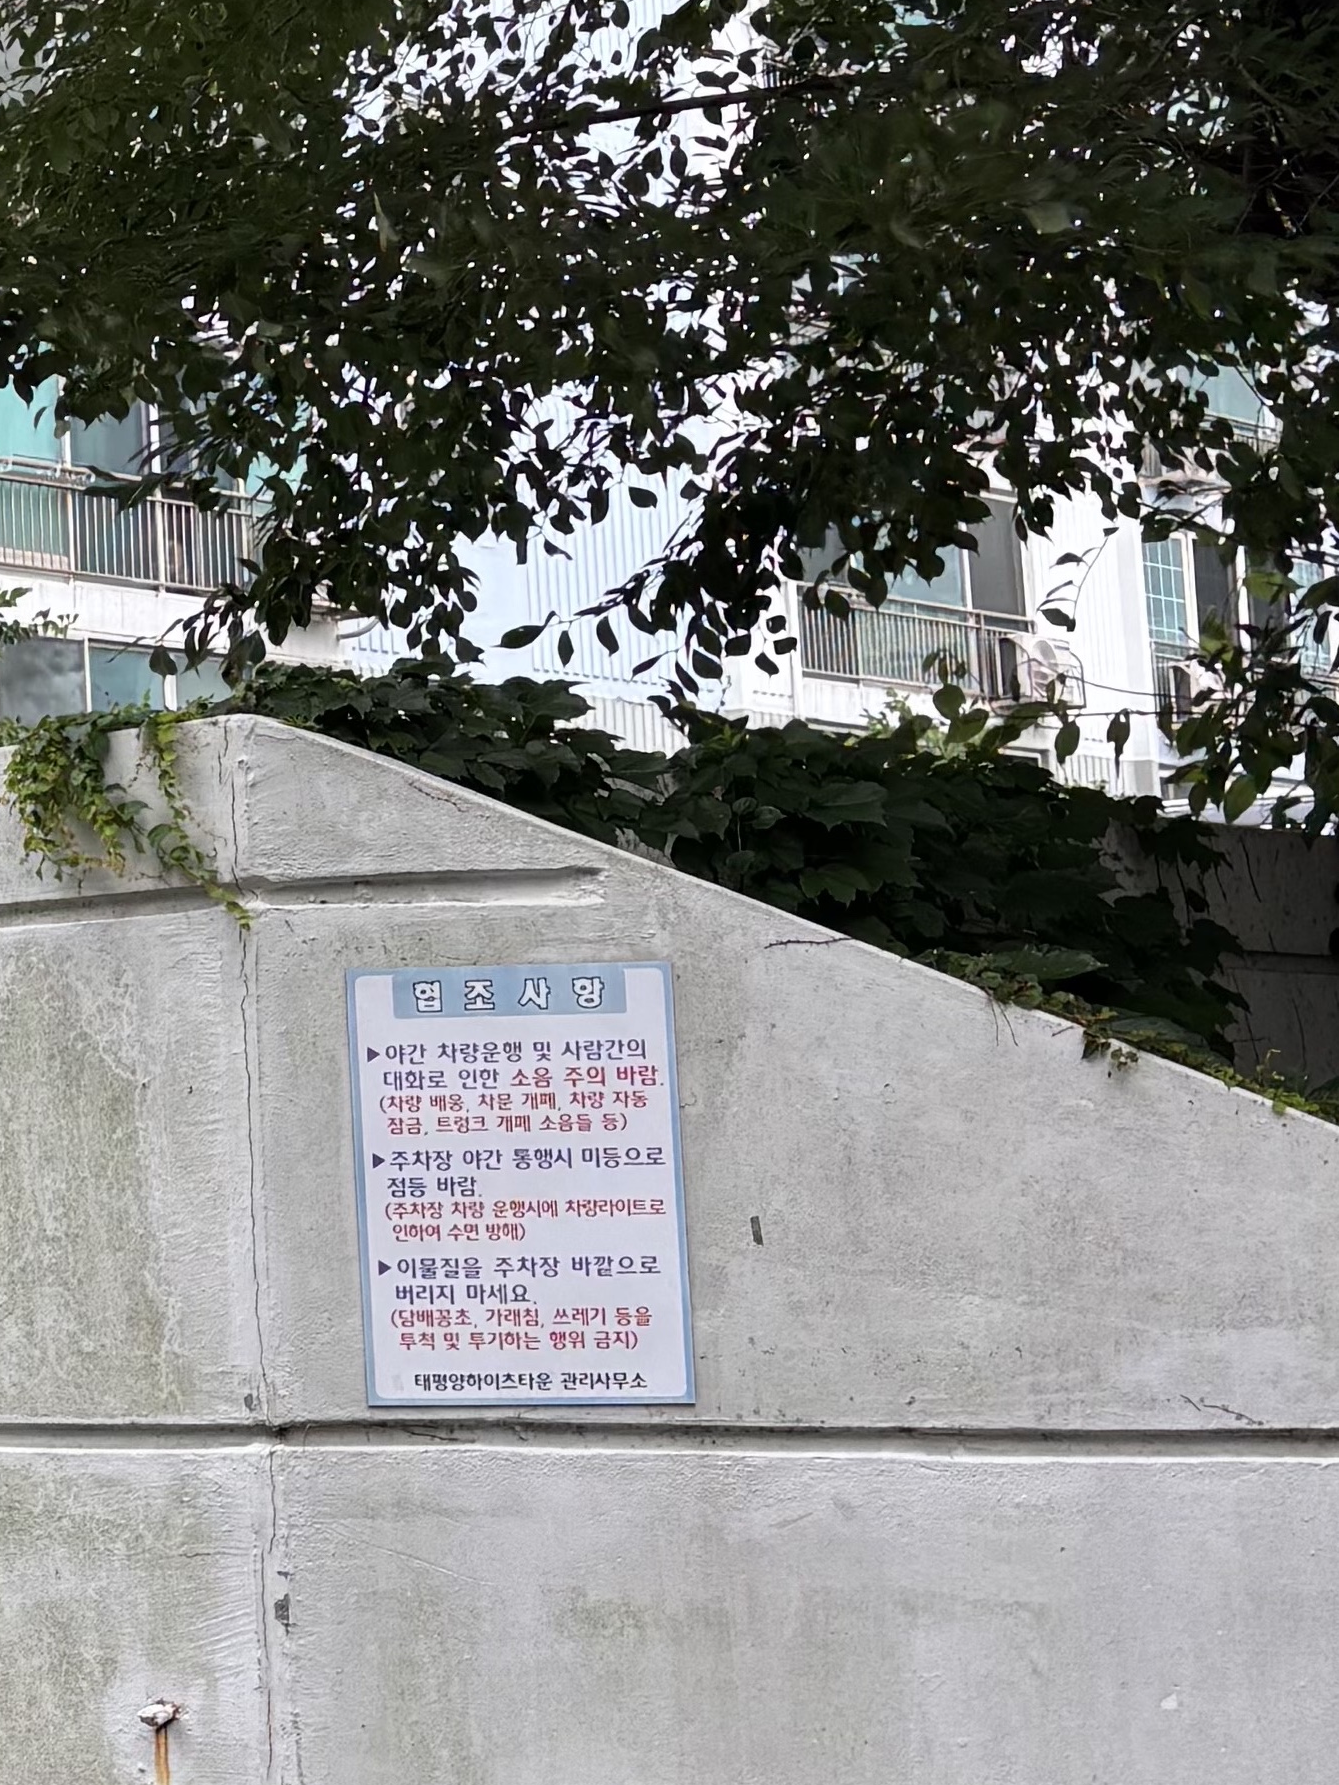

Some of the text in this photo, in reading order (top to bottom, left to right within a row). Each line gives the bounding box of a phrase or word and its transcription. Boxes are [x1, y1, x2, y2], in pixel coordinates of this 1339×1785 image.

[384, 1038, 647, 1066] 야간 차량운행 및 사람간의
[382, 1069, 449, 1092] 대화로
[457, 1067, 501, 1091] 인한
[563, 1065, 607, 1087] 주의
[616, 1064, 664, 1087] 바람.
[378, 1095, 423, 1115] (차량
[477, 1092, 514, 1112] 차문
[569, 1091, 605, 1110] 차량
[612, 1090, 649, 1109] 자동
[386, 1116, 429, 1136] 잠금,
[435, 1114, 489, 1134] 트렁크
[600, 1112, 628, 1131] 등)
[389, 1146, 667, 1172] 주차장 야간 통행시 미등으로
[386, 1176, 483, 1199] 점등 바람.
[384, 1198, 667, 1222] (주차장 차량 운행시에 차량라이트로
[392, 1223, 441, 1243] 인하여
[446, 1223, 480, 1242] 수면
[396, 1256, 483, 1280] 이물질을
[493, 1256, 560, 1278] 주차장
[395, 1283, 538, 1306] 버리지 마세요.
[551, 1307, 607, 1326] 쓰레기
[613, 1306, 653, 1327] 등을
[399, 1330, 639, 1352] 투척 및 투기하는 행위 금지)
[414, 1371, 648, 1392] 태평양하이츠타운 관리사무소
